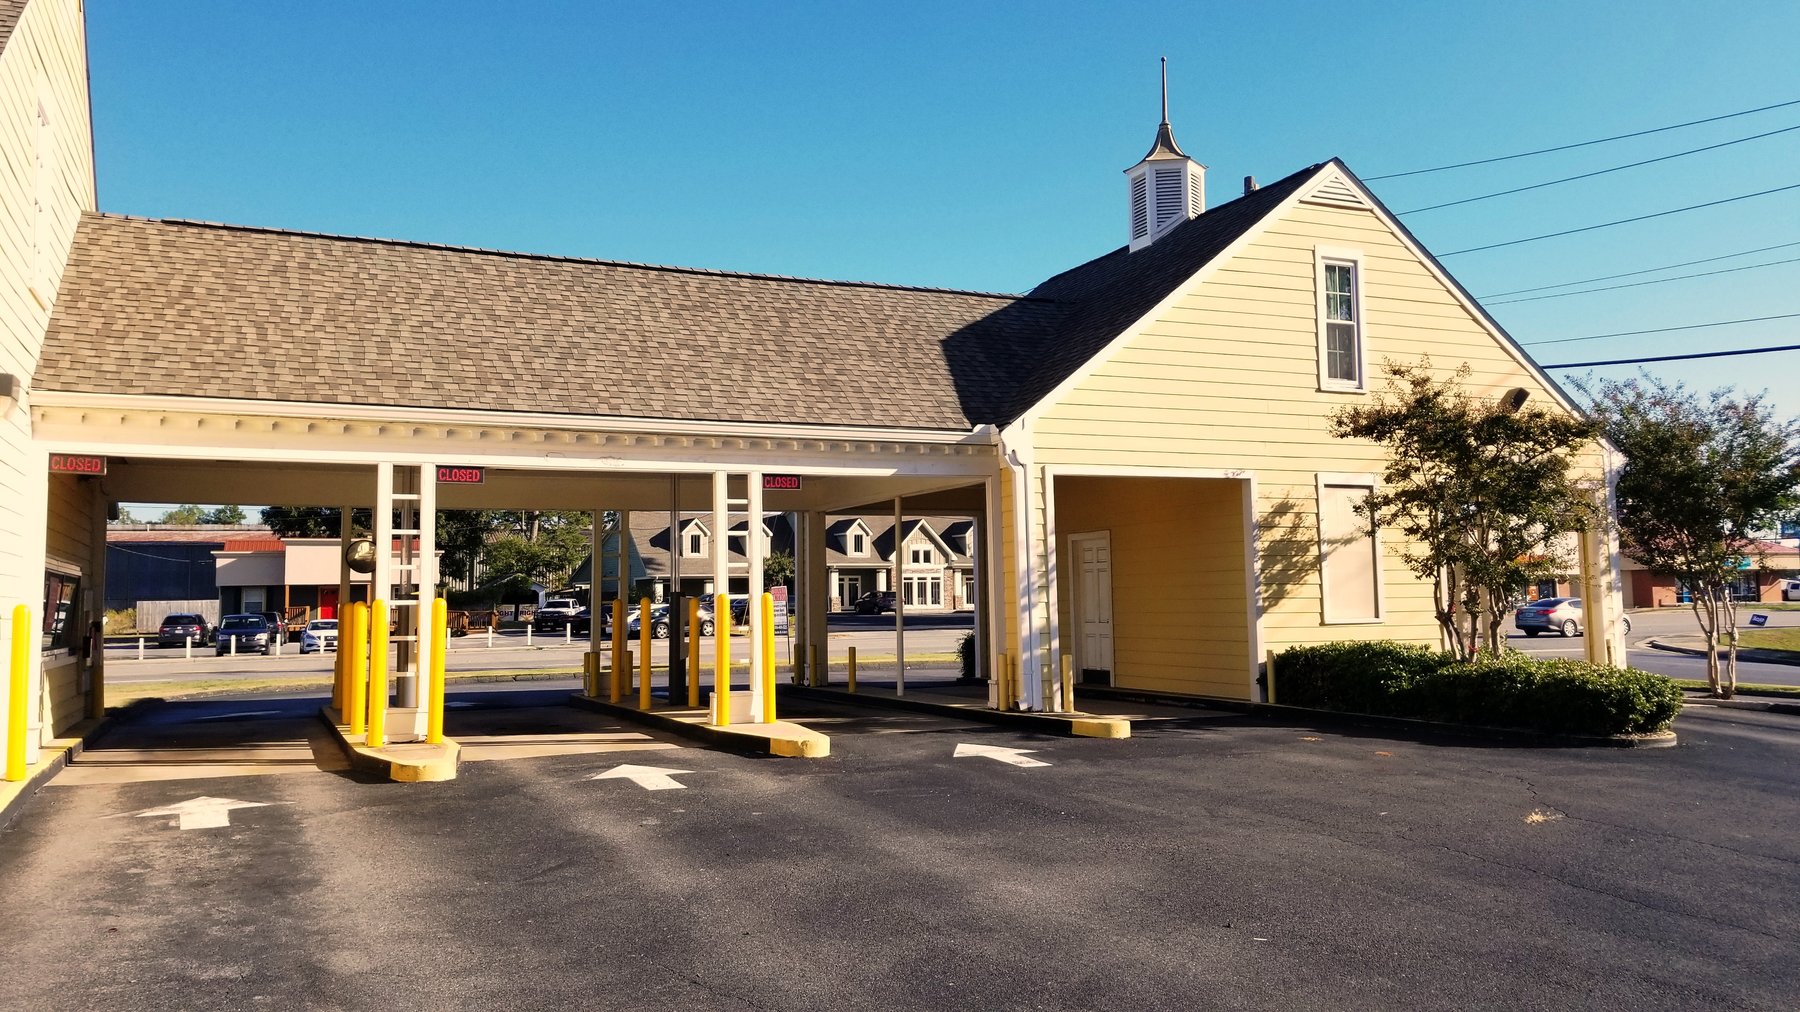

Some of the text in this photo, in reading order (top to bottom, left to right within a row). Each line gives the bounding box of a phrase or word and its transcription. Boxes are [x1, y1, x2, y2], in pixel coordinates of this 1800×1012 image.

[52, 456, 101, 472] CLOSED
[439, 468, 480, 482] CLOSED
[764, 476, 798, 488] CLOSED
